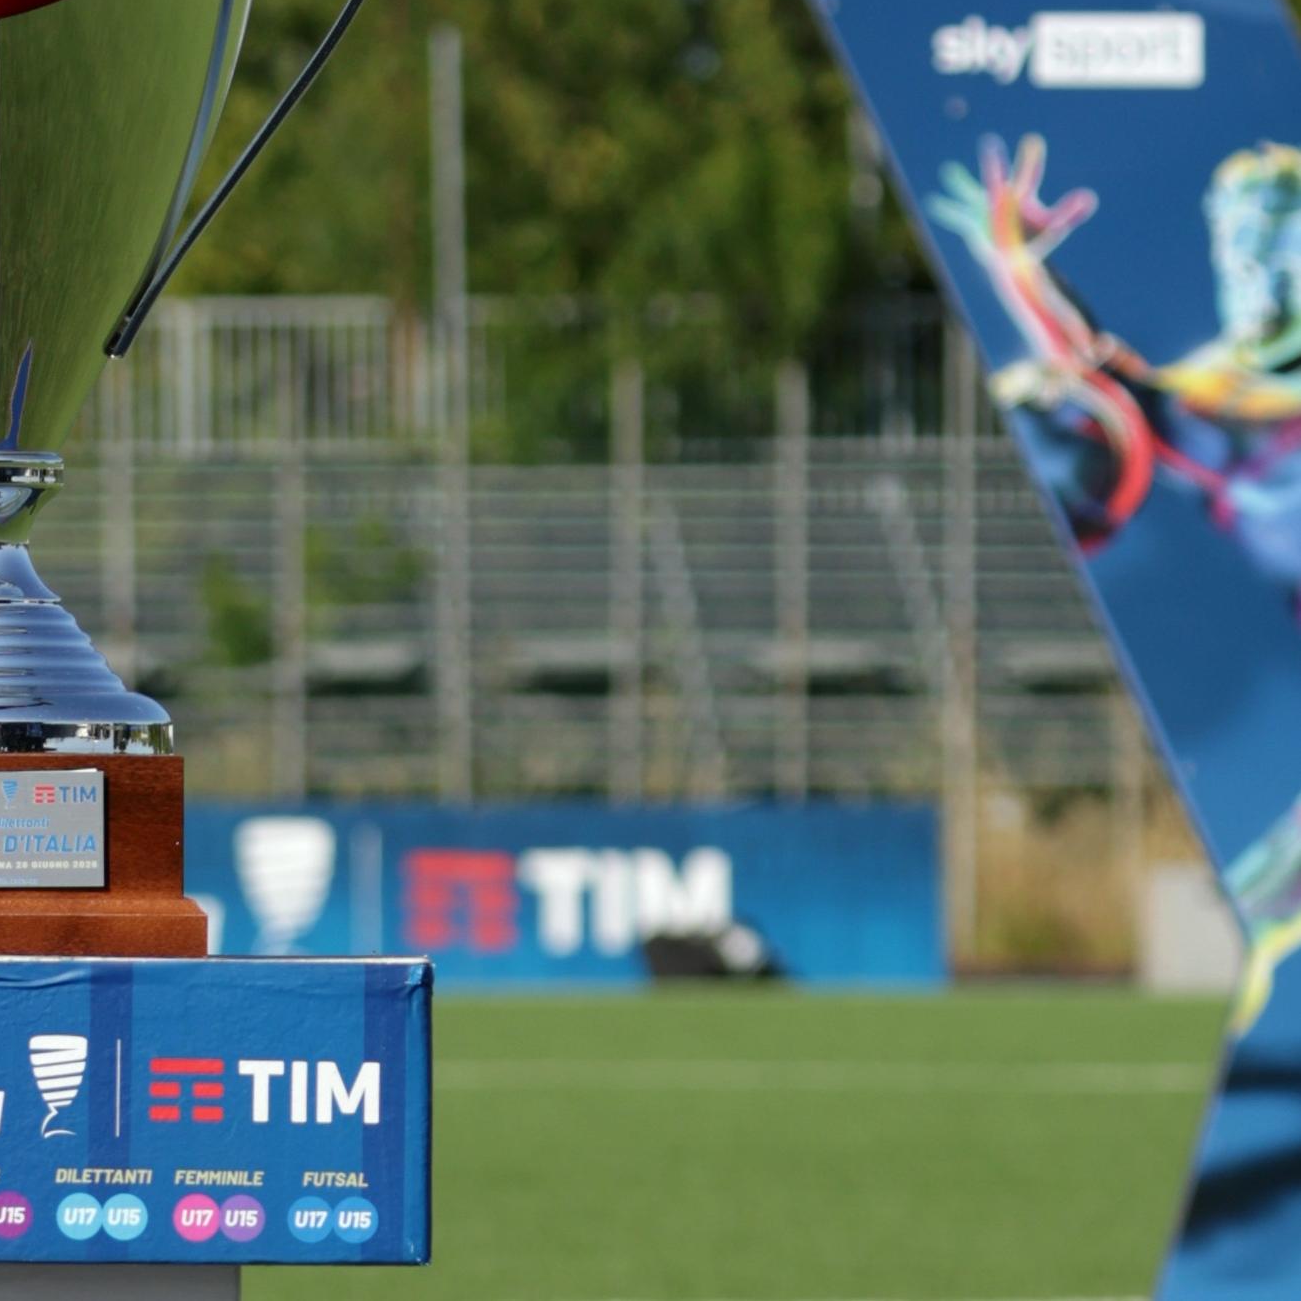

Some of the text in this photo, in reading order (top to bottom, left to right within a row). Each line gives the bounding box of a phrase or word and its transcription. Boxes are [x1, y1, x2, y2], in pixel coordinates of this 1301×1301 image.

[930, 14, 1031, 85] sky
[59, 785, 97, 803] TIM
[4, 834, 97, 853] D'ITALIA
[516, 845, 733, 958] TIM
[238, 1059, 381, 1124] TIM
[55, 1168, 153, 1185] DILETTANTI
[174, 1170, 265, 1186] FEMMINILE
[302, 1171, 369, 1188] FUTSAL
[63, 1207, 141, 1225] U17 U15
[180, 1208, 258, 1227] U17 U15
[294, 1210, 372, 1228] U17 U15
